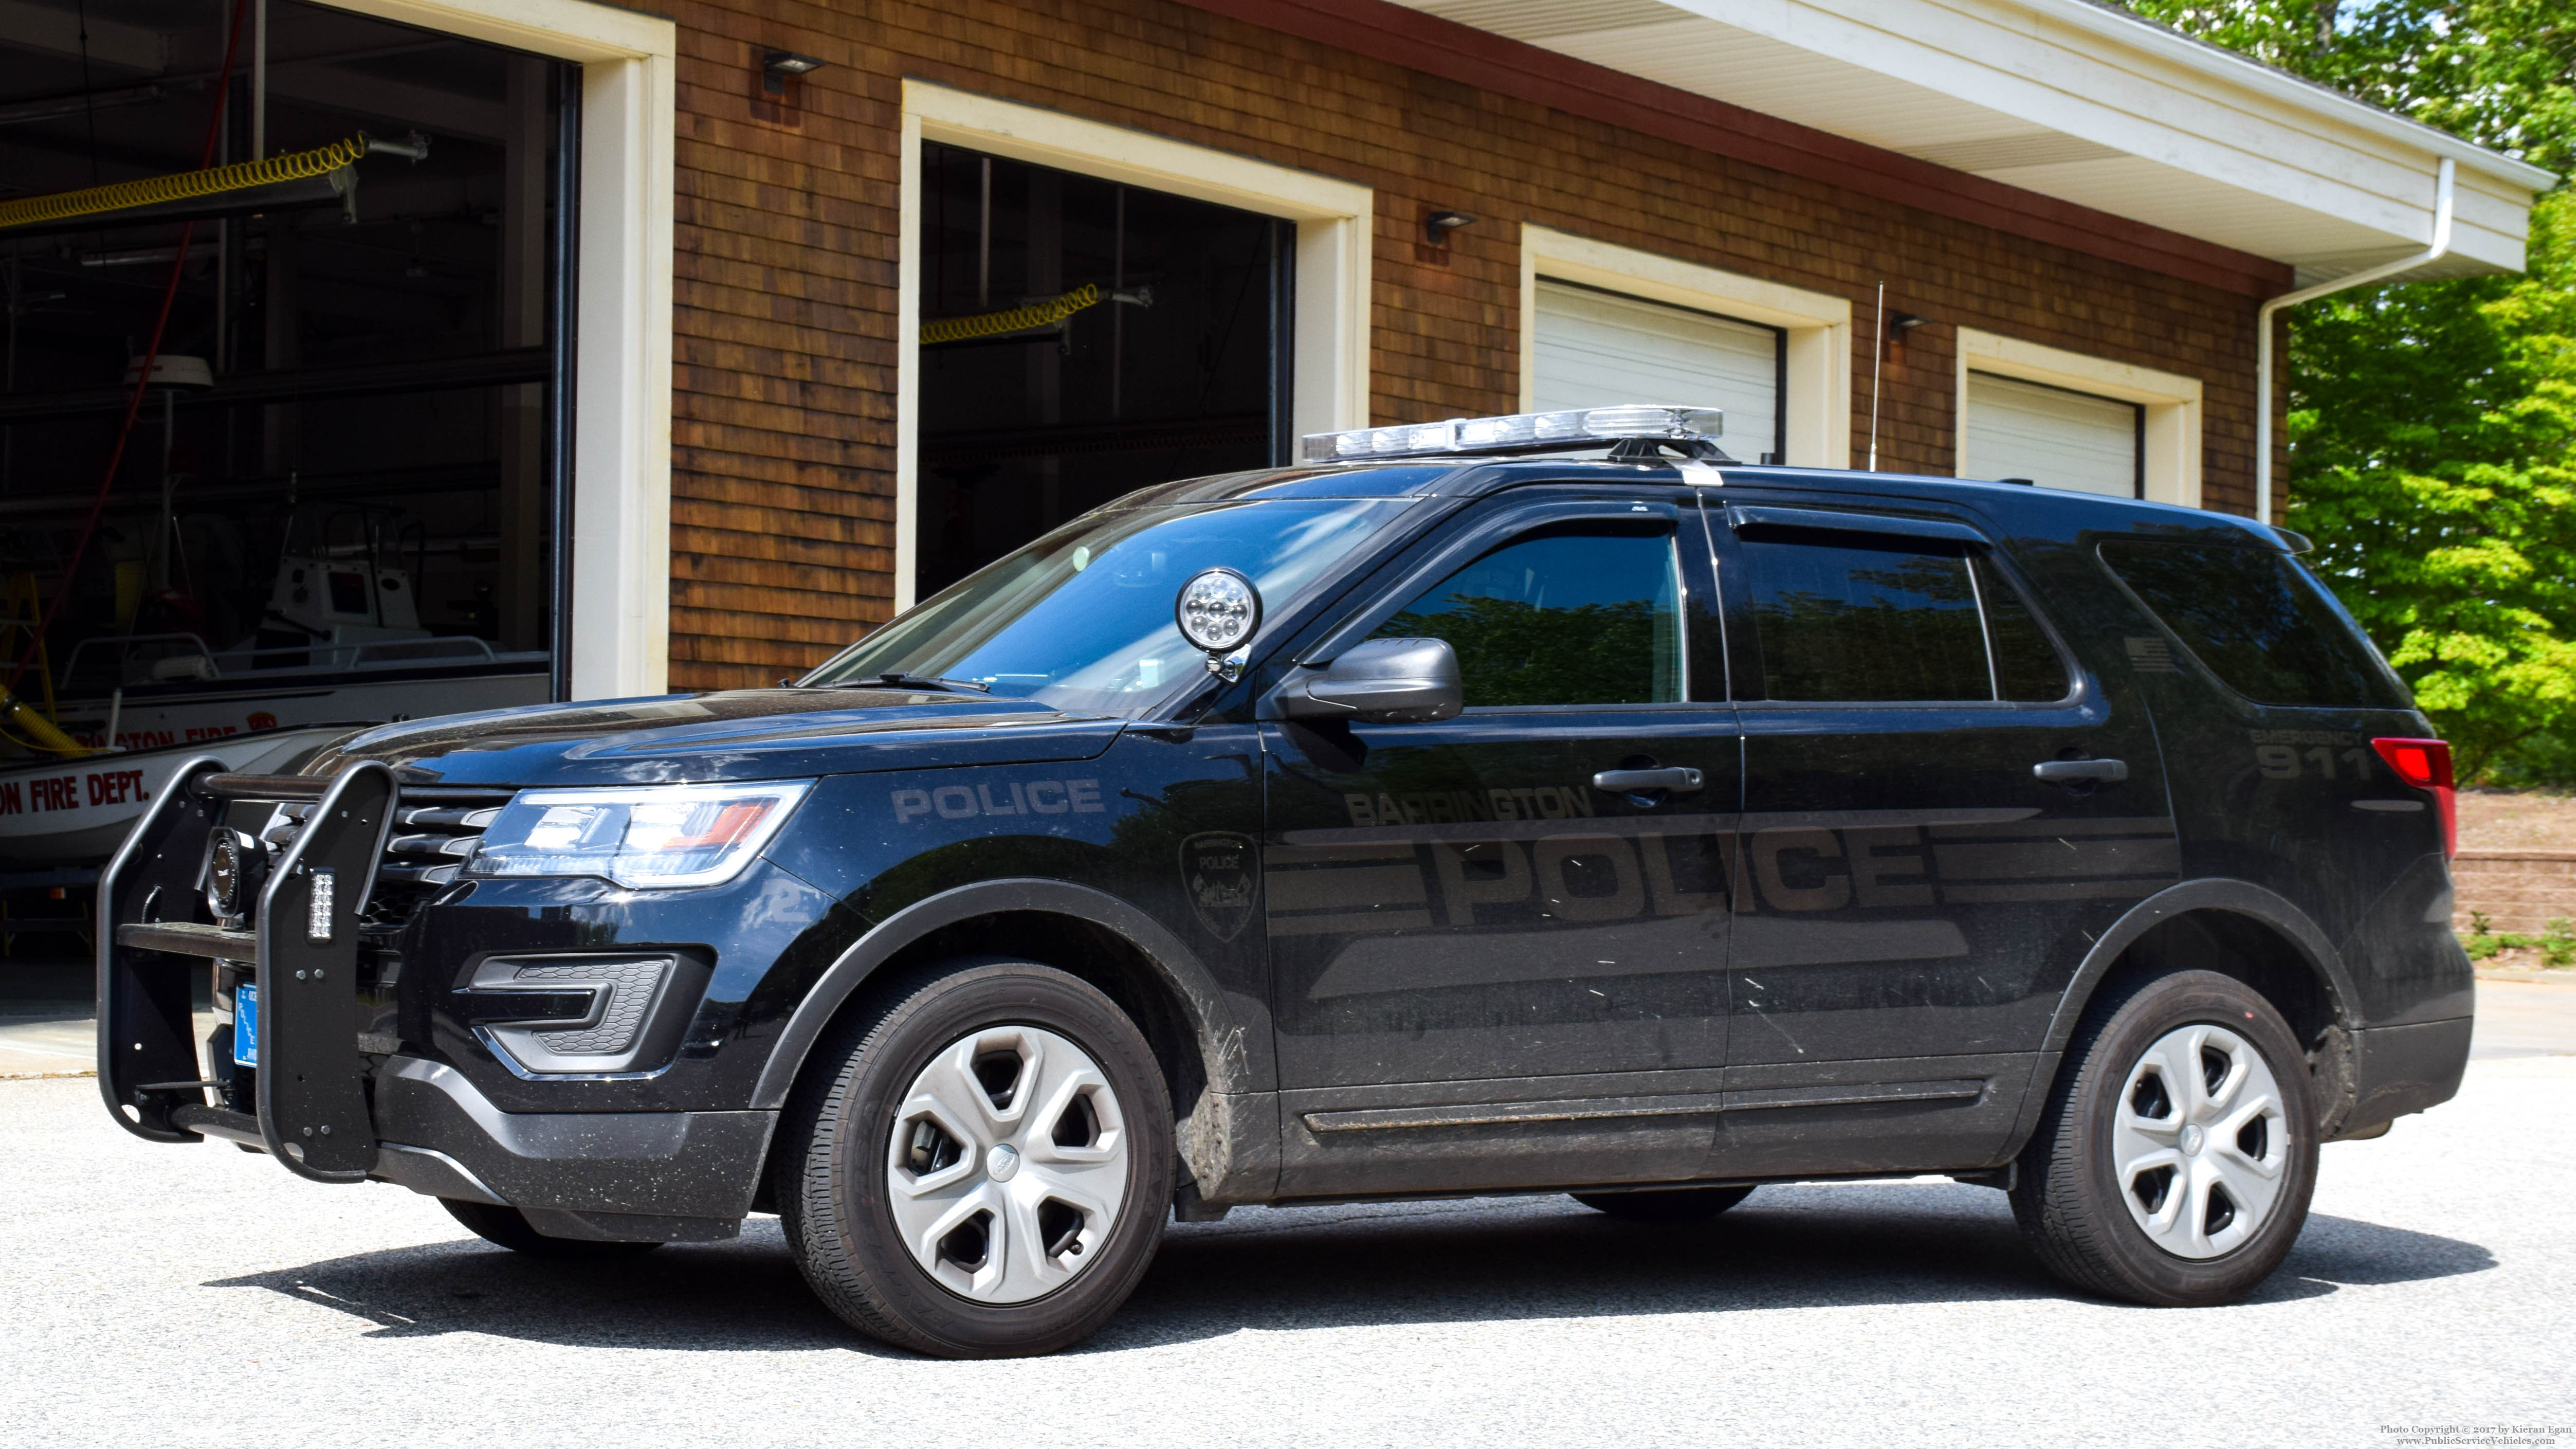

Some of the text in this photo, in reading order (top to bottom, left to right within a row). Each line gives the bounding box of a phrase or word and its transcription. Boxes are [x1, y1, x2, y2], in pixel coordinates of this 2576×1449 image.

[2250, 729, 2364, 745] EMERGENCY
[2256, 745, 2373, 781] 911
[29, 776, 79, 812] FIRE
[86, 770, 150, 806] DEPT.
[890, 778, 1106, 823] POLICE
[1343, 786, 1594, 827] BARRINGTON
[1199, 855, 1240, 870] POLICE
[1430, 826, 1937, 926] POLICE
